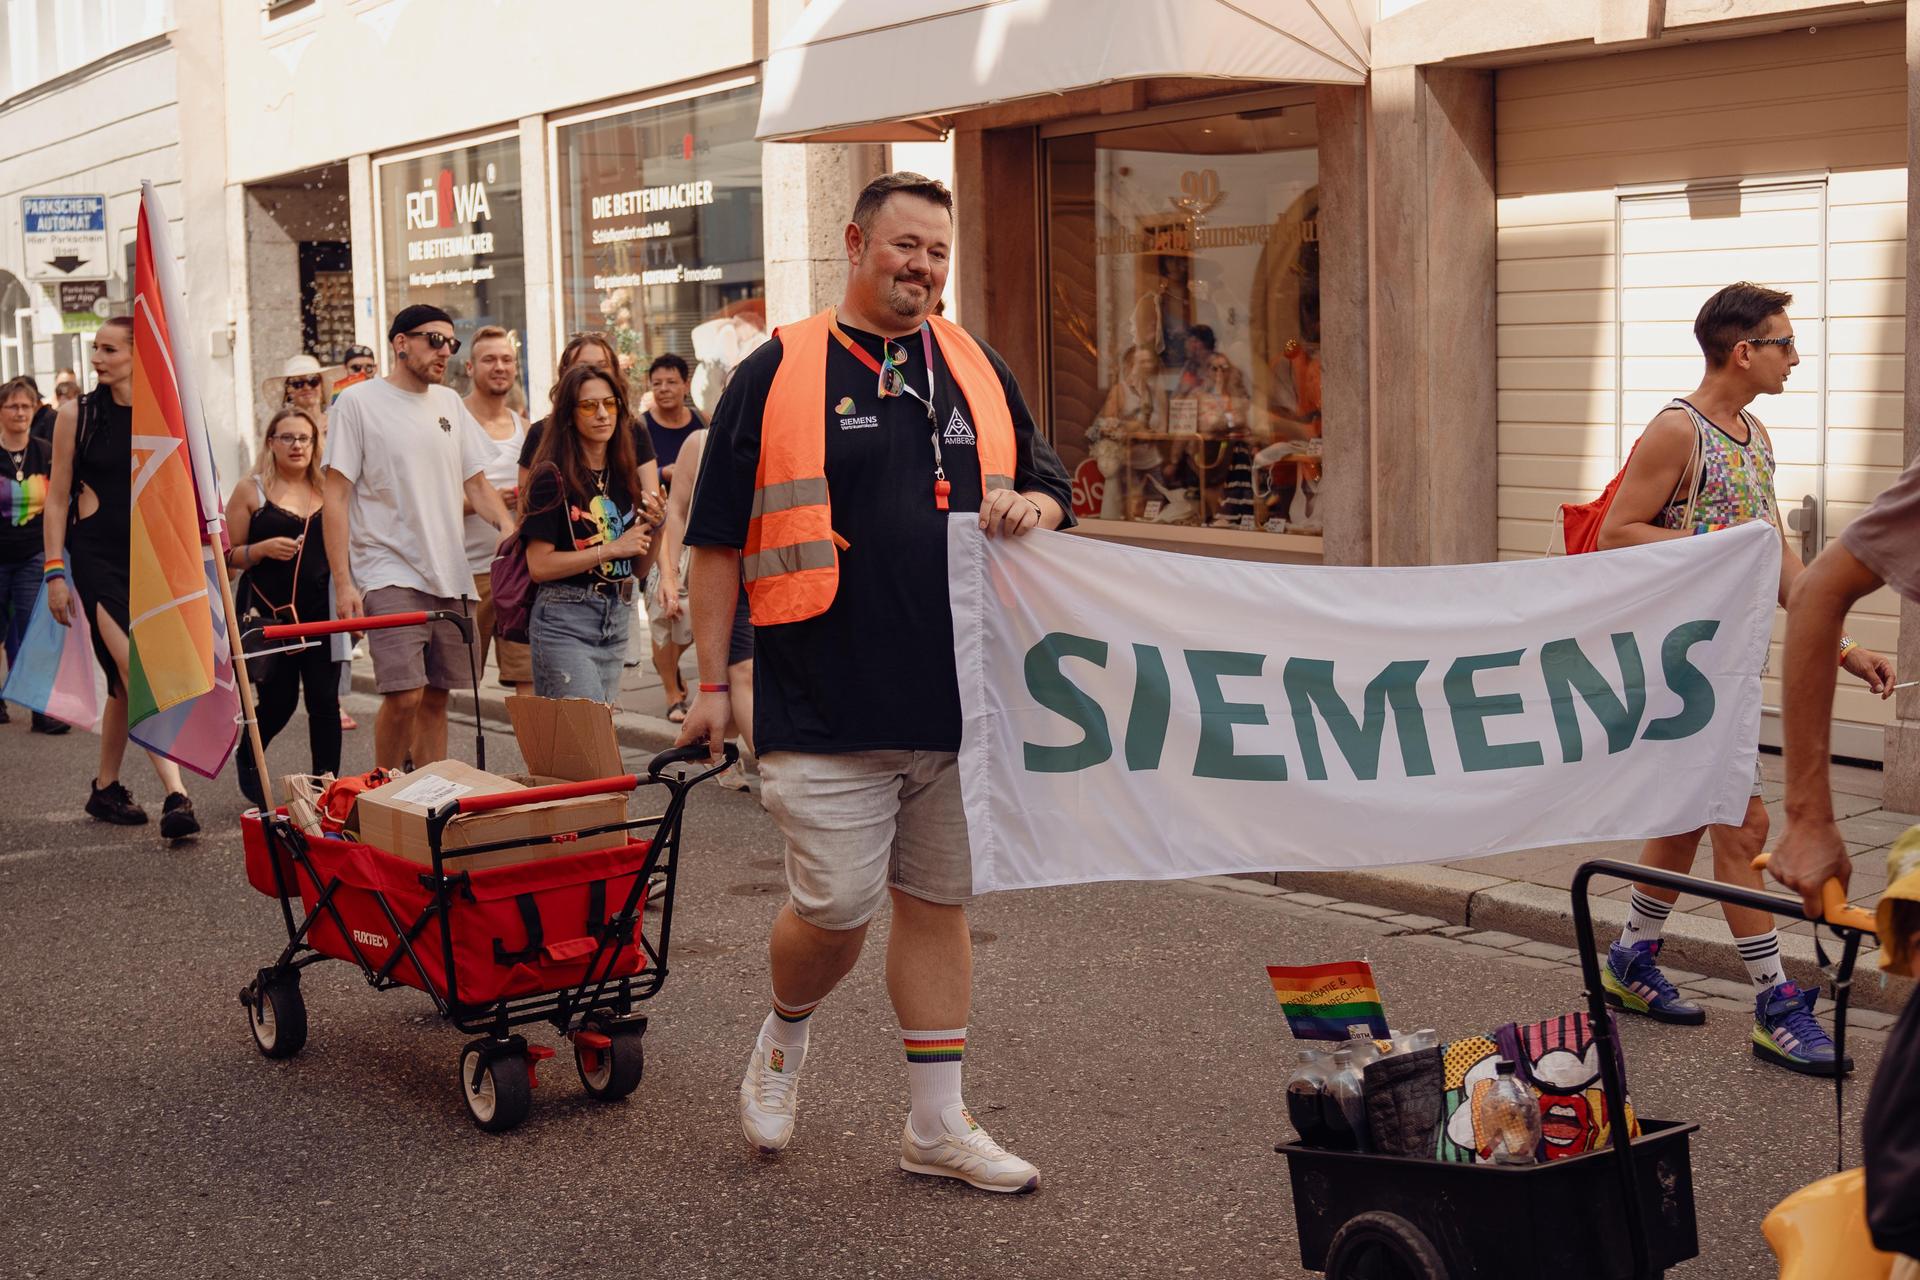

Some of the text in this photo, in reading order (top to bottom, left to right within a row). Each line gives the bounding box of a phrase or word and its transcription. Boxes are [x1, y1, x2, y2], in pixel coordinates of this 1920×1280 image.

[1180, 169, 1219, 204] 90
[25, 198, 101, 215] PARKSCHEIN-
[406, 178, 492, 230] RÖWA
[592, 180, 713, 219] DIE BETTENMACHER
[37, 215, 91, 231] AUTOMAT
[408, 232, 494, 261] DIE BETTENMACHER
[840, 416, 877, 426] SIEMENS
[945, 437, 976, 445] AMBERG
[602, 560, 632, 577] PAU
[1023, 619, 1720, 782] SIEMENS
[353, 929, 384, 948] FUXTEC
[1286, 976, 1348, 1007] DEMOKRATIE &
